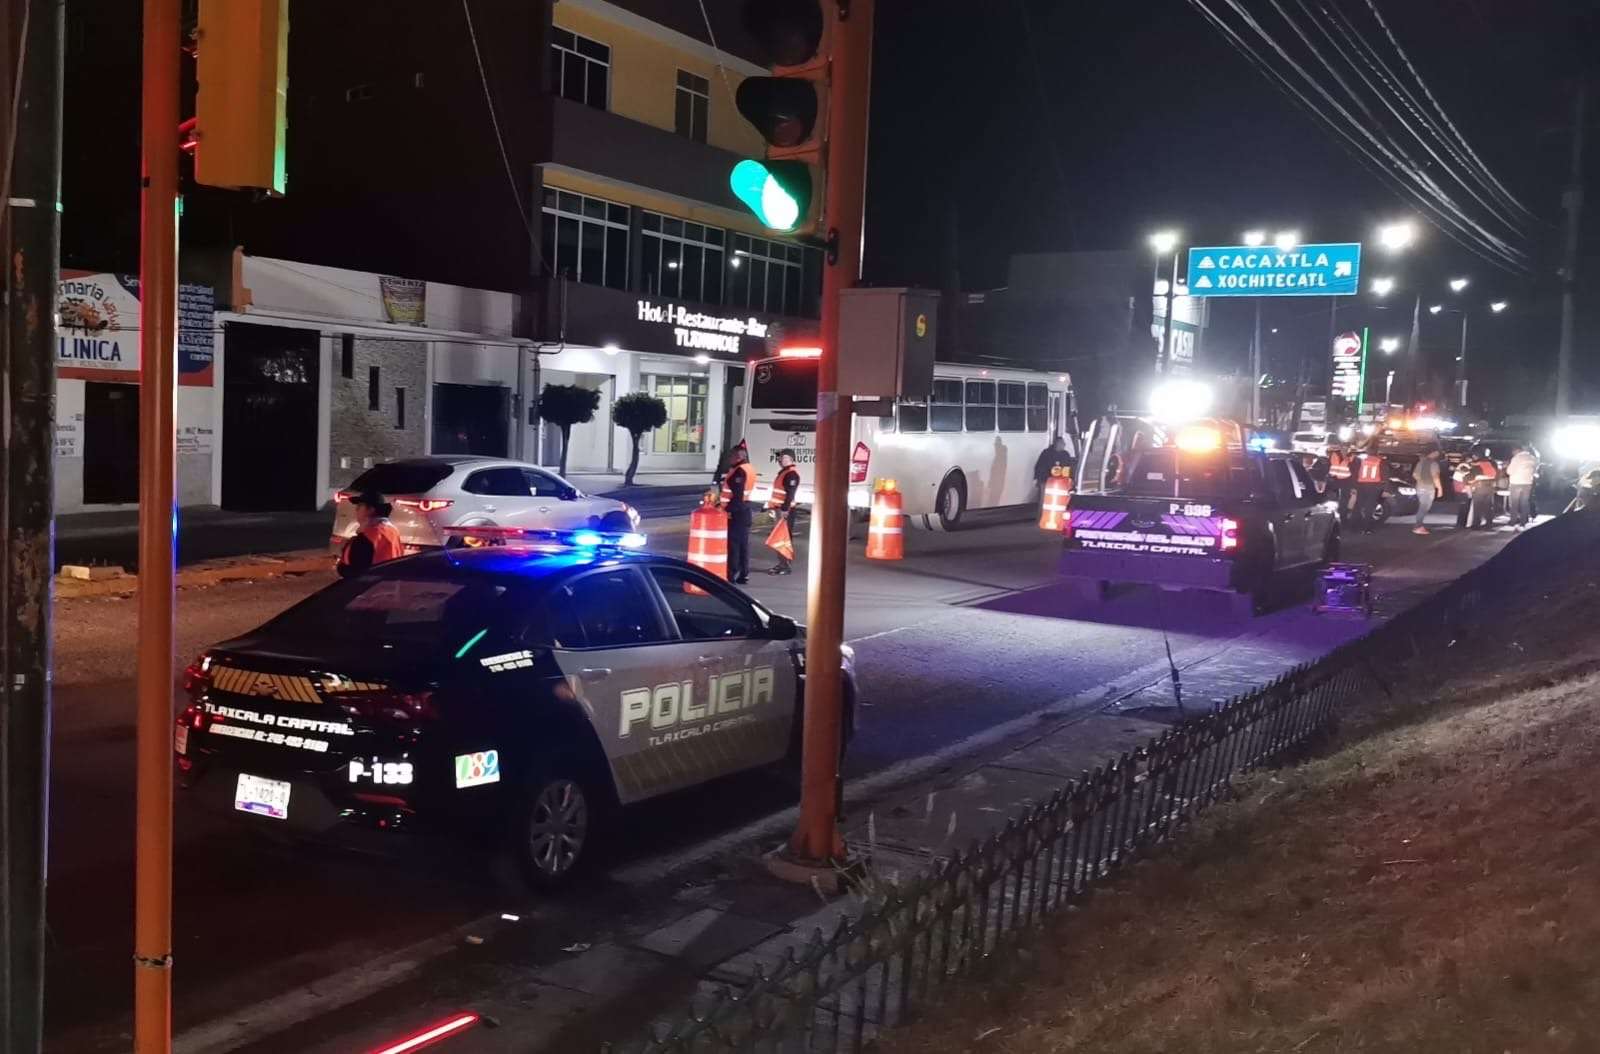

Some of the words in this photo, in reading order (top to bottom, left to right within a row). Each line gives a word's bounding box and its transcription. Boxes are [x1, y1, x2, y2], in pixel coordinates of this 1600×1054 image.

[1218, 252, 1329, 269] CACAXTLA
[58, 280, 104, 301] rinaria
[1217, 272, 1328, 289] XOCHITECATL
[916, 313, 926, 338] 6
[60, 337, 122, 361] LINICA
[1081, 540, 1149, 551] TLAXCALA
[1150, 545, 1209, 555] CAPITAL
[619, 654, 775, 739] POLICÍA
[204, 702, 275, 725] TLAXCALA
[276, 715, 355, 735] CAPITAL
[648, 723, 712, 746] TLAXCALA
